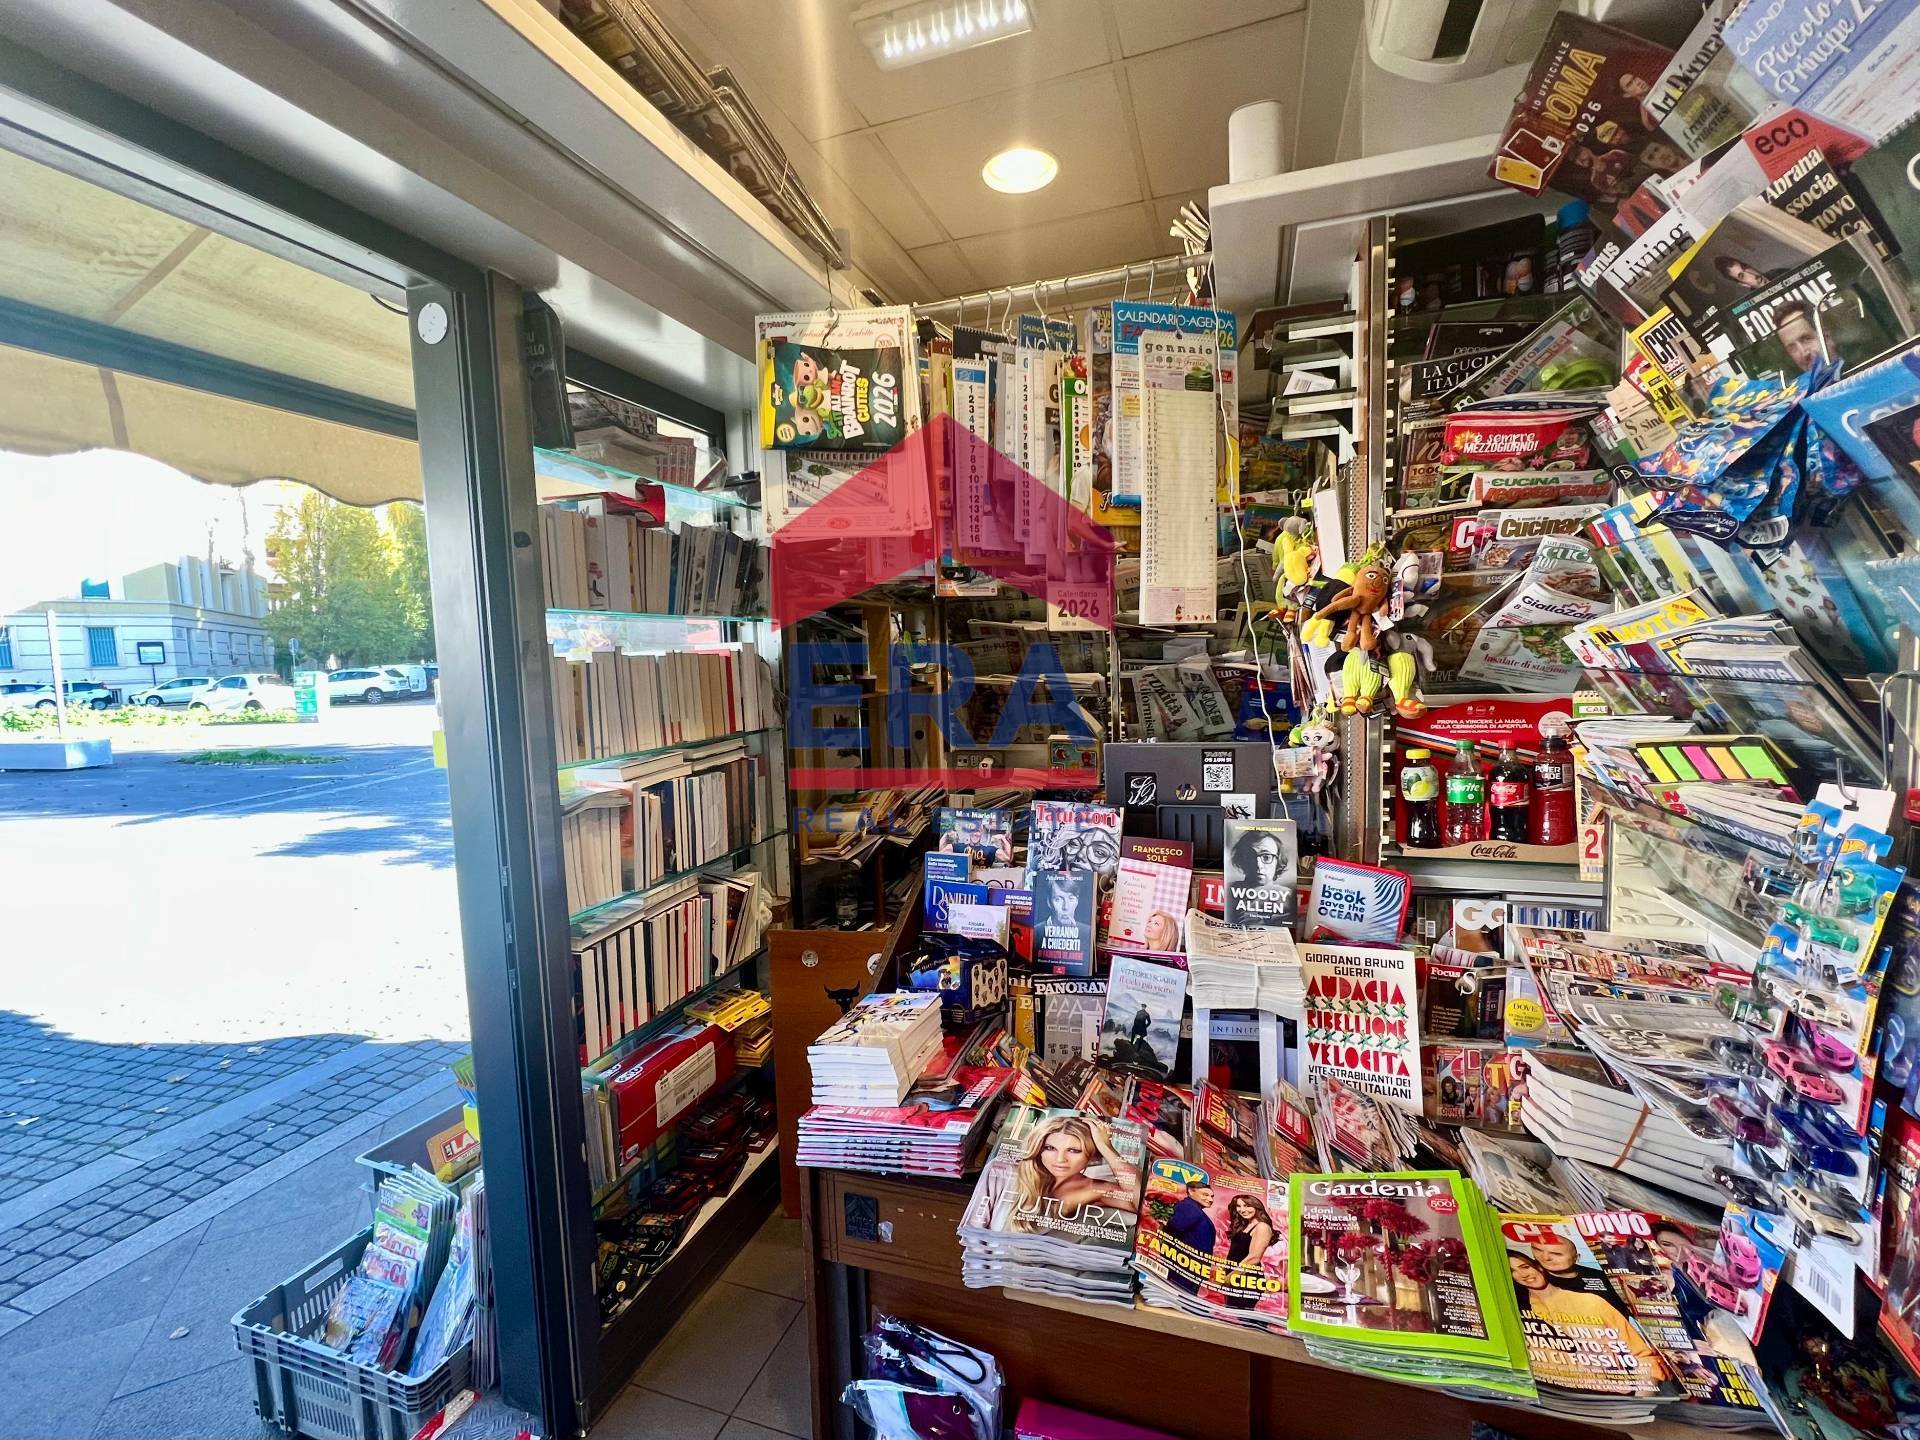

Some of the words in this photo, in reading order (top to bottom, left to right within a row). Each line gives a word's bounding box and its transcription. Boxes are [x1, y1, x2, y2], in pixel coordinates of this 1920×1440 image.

[1539, 40, 1570, 96] UFFICIALE
[1576, 100, 1602, 133] 026
[1755, 118, 1809, 154] eco
[1580, 240, 1620, 287] domus
[1610, 223, 1688, 288] Living
[1145, 342, 1213, 355] gennaio
[1423, 364, 1443, 380] LA
[1501, 350, 1537, 387] IMBUTO
[840, 359, 865, 440] BRAINROT
[856, 377, 871, 423] CUTIES
[872, 371, 898, 429] 2026
[1463, 440, 1539, 454] MEZZOGIORNO!
[1488, 431, 1536, 448] sempre
[1491, 476, 1560, 488] CUCINA
[1057, 589, 1099, 598] Calendario
[1057, 598, 1100, 618] 2026
[1594, 631, 1619, 646] IN
[1520, 659, 1531, 668] di
[1450, 782, 1482, 796] Sprite
[1036, 803, 1117, 827] Tatuatori
[1132, 844, 1184, 857] FRANCESCO
[1146, 854, 1168, 863] SOLE
[1230, 886, 1291, 901] WOODY
[1321, 883, 1367, 906] book
[1327, 885, 1343, 893] Save
[1344, 887, 1356, 896] this
[1236, 900, 1285, 915] ALLEN
[1317, 906, 1365, 923] OCEAN
[1320, 898, 1345, 911] save
[1348, 903, 1366, 914] the
[1043, 925, 1079, 939] VERRANNO
[1047, 938, 1081, 951] CHIEDERTI
[1305, 953, 1361, 967] GIORDANO
[1364, 957, 1404, 970] BRUNO
[1334, 966, 1374, 978] GUERRI
[1430, 966, 1462, 978] Focus
[1307, 976, 1406, 1005] AUDACIA
[1306, 1009, 1407, 1040] RIBELLIONE
[1308, 1064, 1326, 1075] VITE
[1327, 1068, 1395, 1086] STRABILIANTI
[1396, 1077, 1411, 1088] DEI
[1365, 1081, 1412, 1100] ITALIANI
[1309, 1179, 1442, 1199] Gardenia
[1310, 1206, 1334, 1214] doni
[1321, 1214, 1358, 1222] Natale
[1575, 1213, 1651, 1237] UOVO
[1138, 1233, 1211, 1279] L'AMORE
[1230, 1273, 1281, 1293] CIECO
[1526, 1335, 1606, 1352] VAMPITO:
[1609, 1340, 1628, 1353] SE
[1550, 1352, 1566, 1364] CI
[1572, 1352, 1618, 1368] FOSSI
